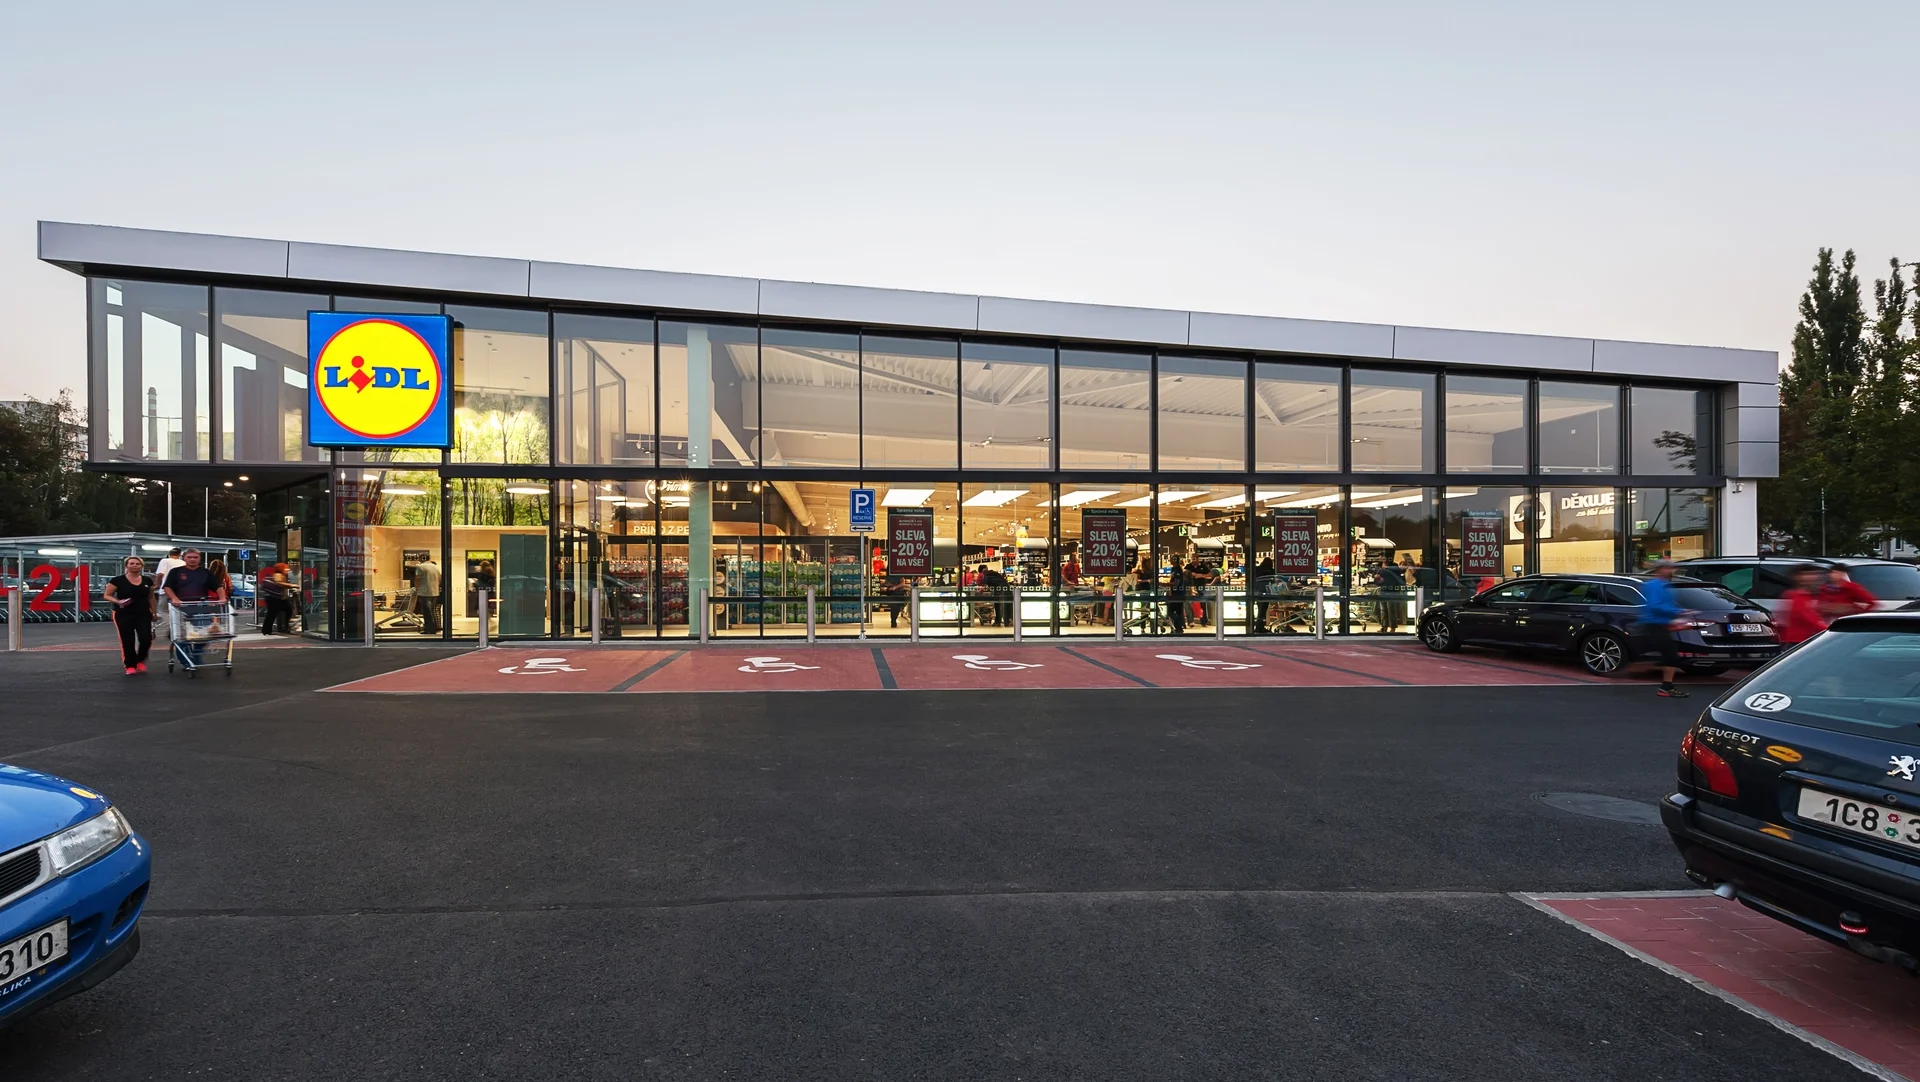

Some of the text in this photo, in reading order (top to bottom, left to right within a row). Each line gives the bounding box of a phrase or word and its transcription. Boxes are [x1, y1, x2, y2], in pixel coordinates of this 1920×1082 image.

[855, 493, 870, 514] P
[1561, 490, 1637, 510] DĚKUJEE
[677, 526, 690, 535] PE
[895, 529, 926, 541] SLEVA
[1090, 531, 1119, 541] SLEVA
[1281, 530, 1310, 541] SLEVA
[1468, 531, 1497, 542] SLEVA
[892, 542, 929, 556] -20 %
[1086, 543, 1122, 557] -20 %
[1278, 543, 1314, 556] -20 %
[1464, 544, 1500, 557] -20 %
[896, 557, 924, 567] NA VŠE!
[1091, 557, 1117, 567] NA VŠE!
[1282, 557, 1309, 566] NA VŠE!
[1469, 558, 1495, 567] NA VŠE!
[1702, 726, 1760, 745] PEUGEOT
[1826, 798, 1879, 832] 1C8
[0, 931, 53, 980] 310
[0, 976, 32, 997] LIKA
